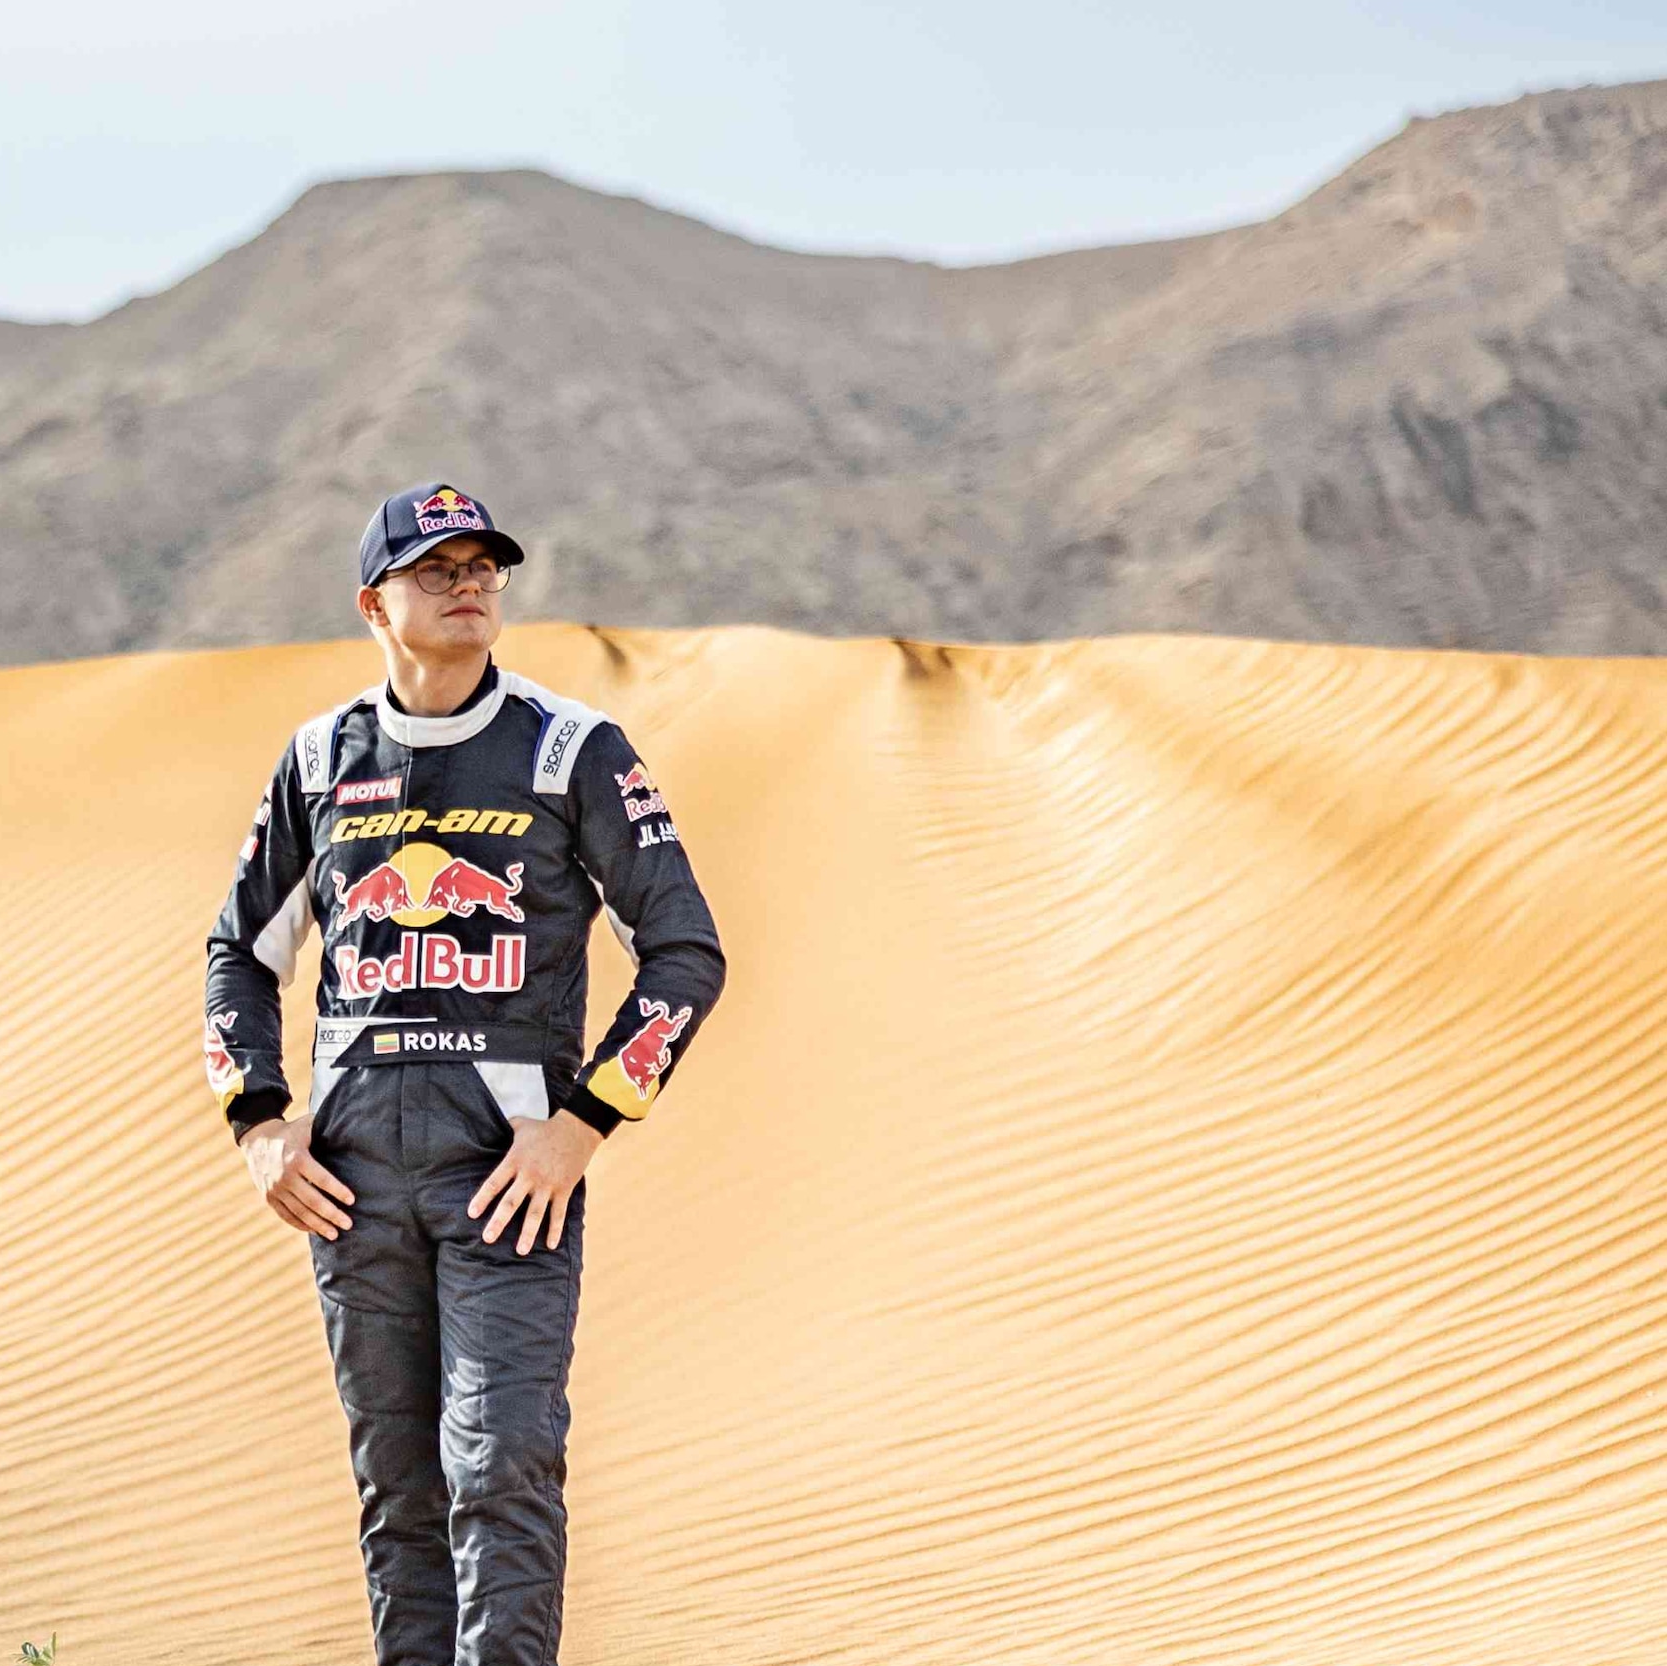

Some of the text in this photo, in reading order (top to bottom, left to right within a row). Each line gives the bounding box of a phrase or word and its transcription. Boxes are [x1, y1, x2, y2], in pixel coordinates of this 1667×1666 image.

[417, 511, 456, 535] Red
[543, 720, 577, 776] sparco
[341, 778, 399, 801] MOTUL
[330, 808, 534, 843] can-am
[335, 932, 527, 1000] Red Bull
[404, 1032, 487, 1051] ROKAS
